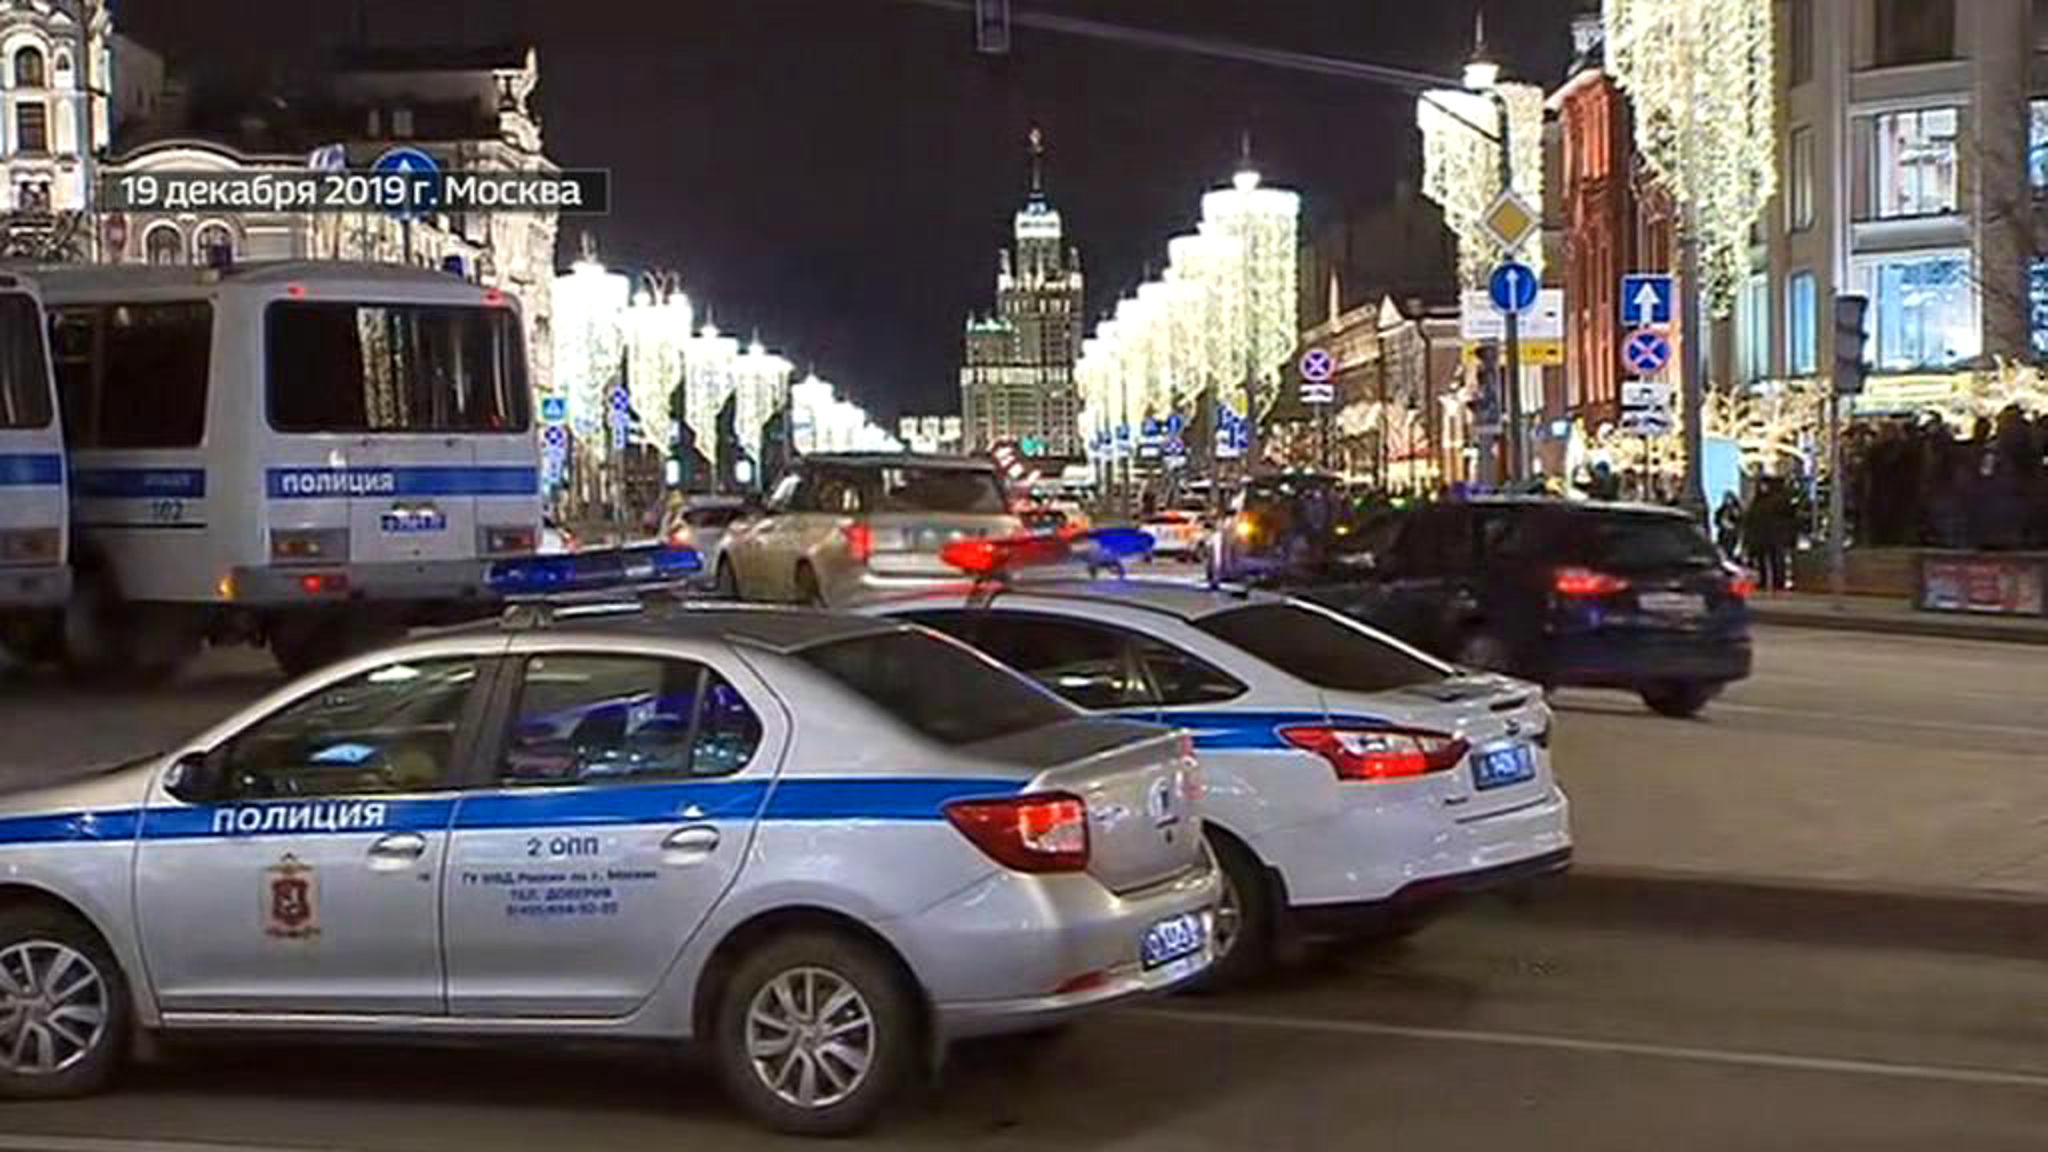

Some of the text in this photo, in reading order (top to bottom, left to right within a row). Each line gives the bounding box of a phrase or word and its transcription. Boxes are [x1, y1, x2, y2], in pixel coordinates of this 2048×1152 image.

[212, 802, 387, 833] ПОЛИЦИЯ
[527, 836, 599, 857] 2 ОПП
